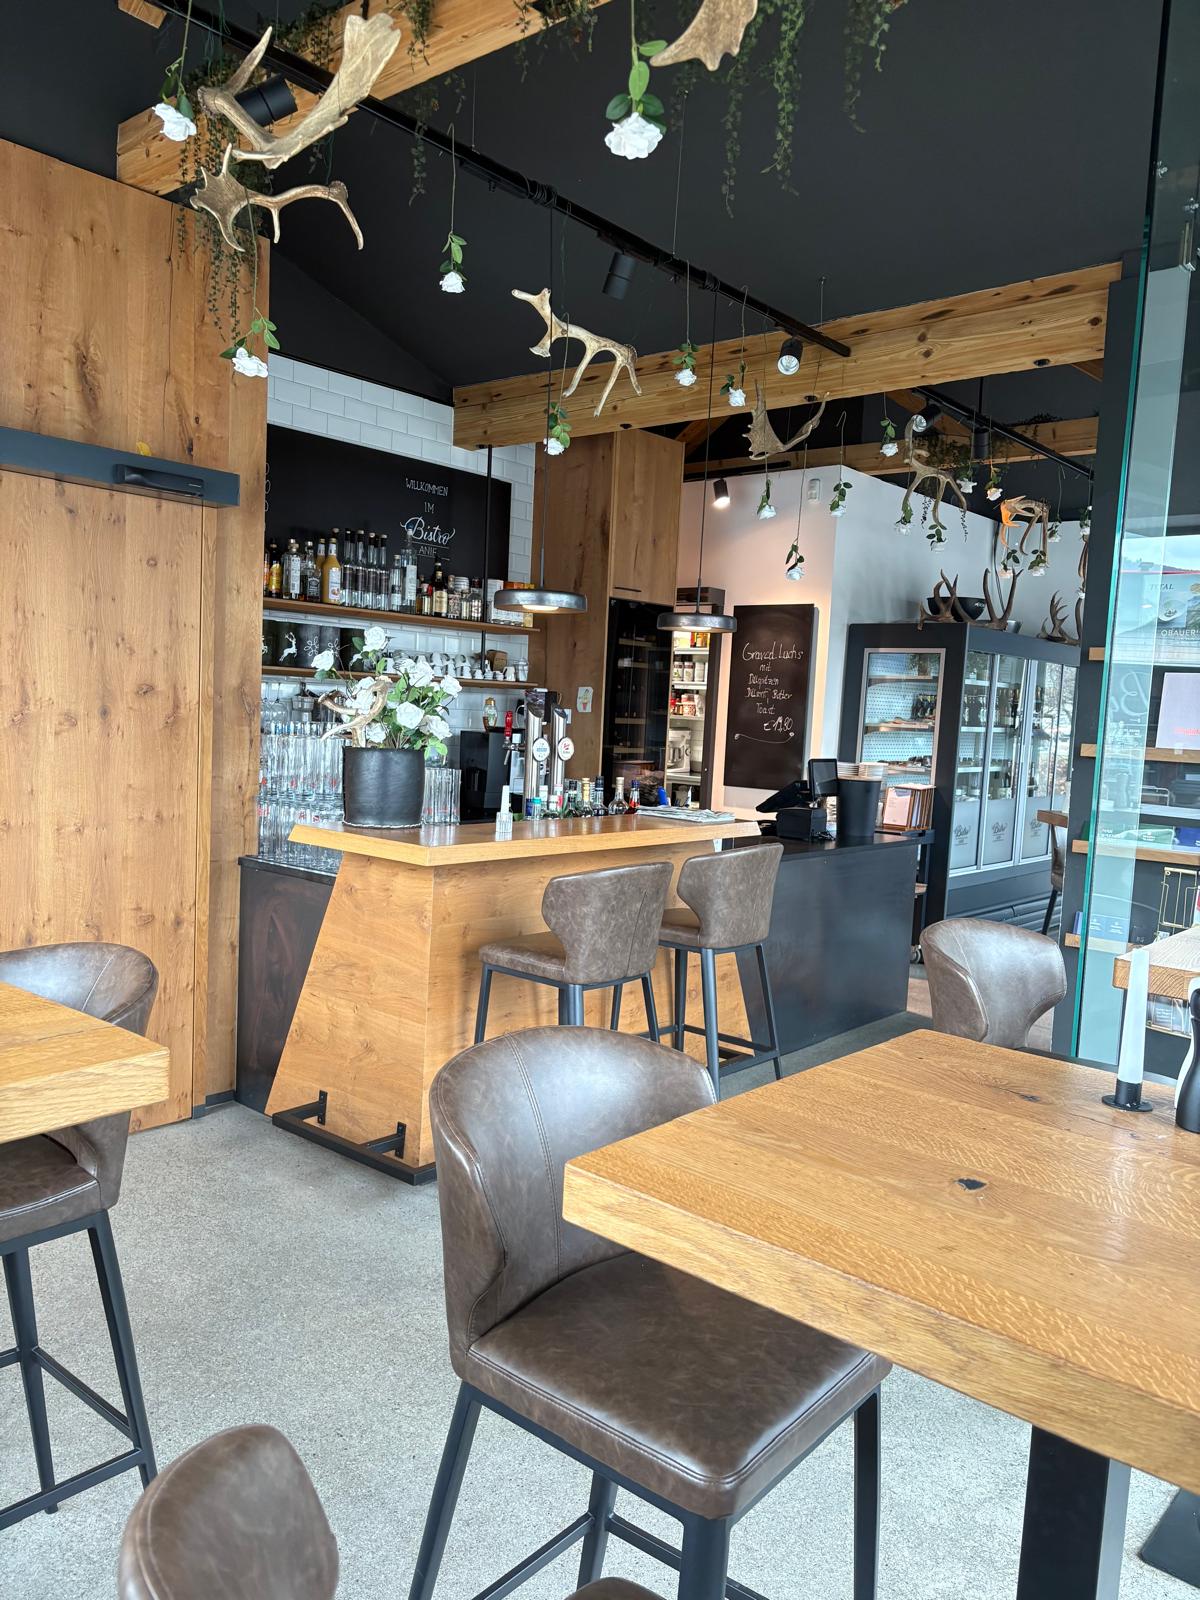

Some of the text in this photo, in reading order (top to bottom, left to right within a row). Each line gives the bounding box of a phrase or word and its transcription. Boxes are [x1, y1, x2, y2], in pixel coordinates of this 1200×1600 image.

[405, 478, 449, 497] WILLKOMMEN
[424, 501, 435, 514] IM
[400, 516, 456, 545] Bistro
[756, 702, 776, 715] Toast
